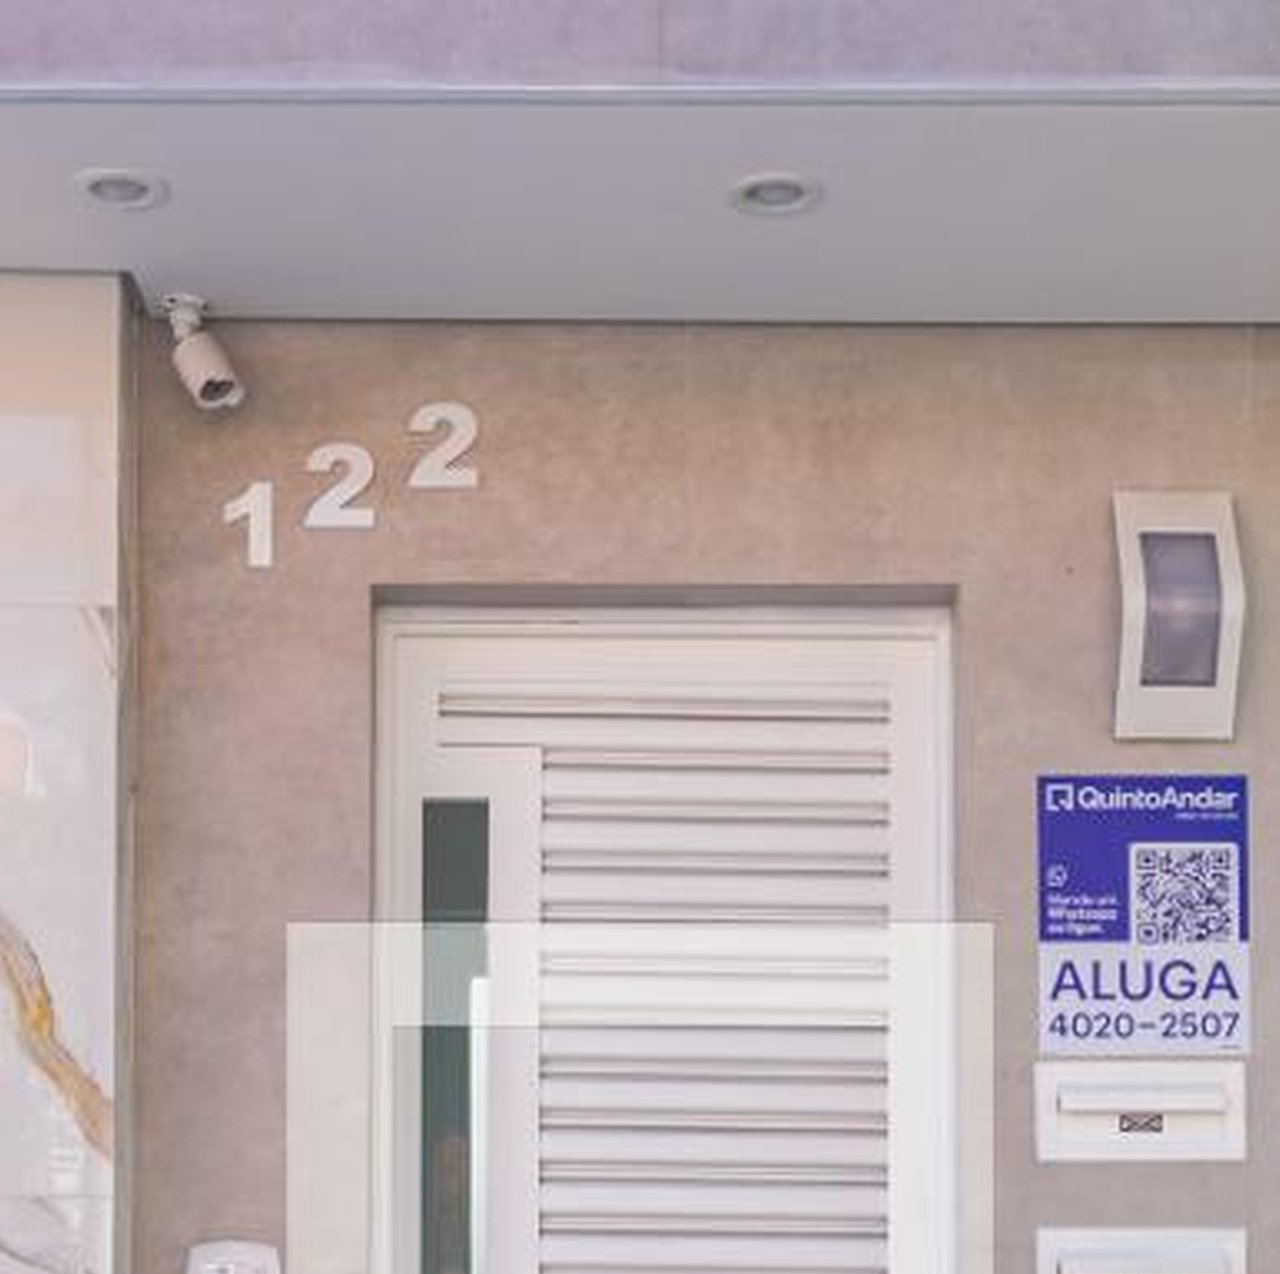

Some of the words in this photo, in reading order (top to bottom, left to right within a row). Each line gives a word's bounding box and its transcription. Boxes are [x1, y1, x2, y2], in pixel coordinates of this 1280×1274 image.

[223, 401, 478, 567] 122
[1078, 785, 1238, 811] QuintoAndar
[1051, 960, 1239, 1000] ALUGA
[1049, 1013, 1240, 1038] 4020-2507
